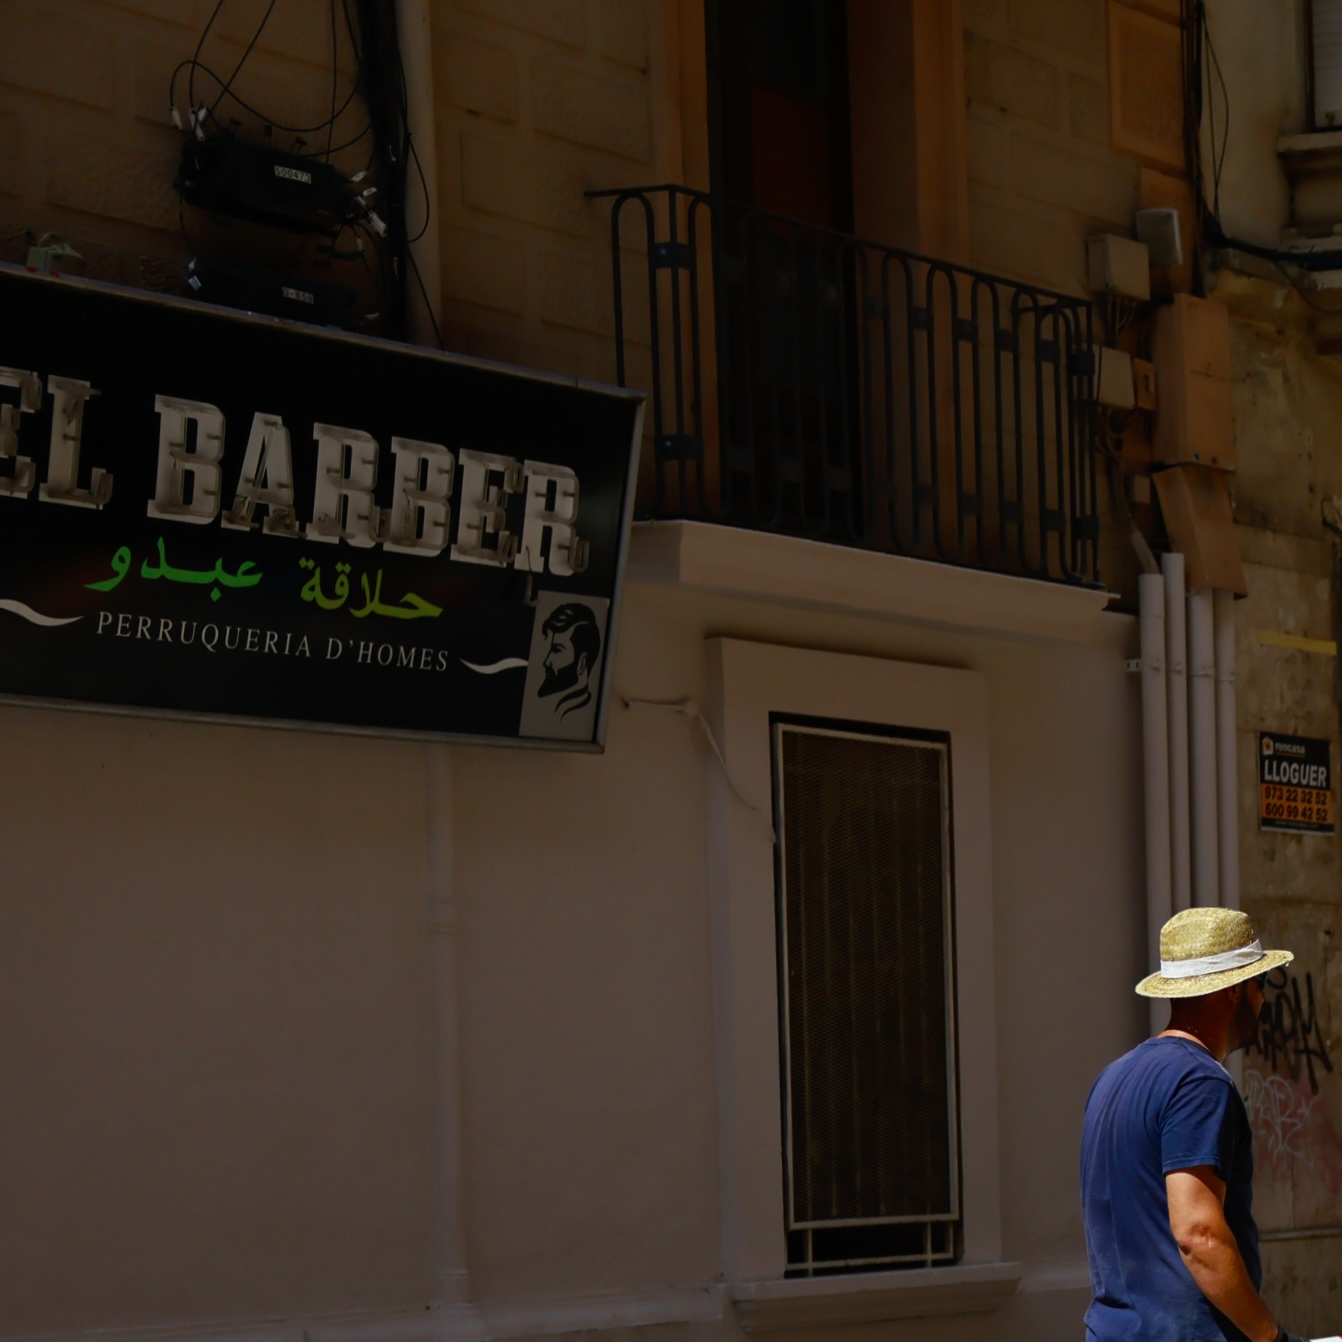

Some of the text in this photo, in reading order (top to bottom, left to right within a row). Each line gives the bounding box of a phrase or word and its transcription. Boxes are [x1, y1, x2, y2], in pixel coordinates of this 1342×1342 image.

[147, 394, 590, 577] BARBER
[83, 535, 444, 620] حلاقة عبدو
[95, 610, 449, 672] PERRUQUERIA D'HOMES
[1263, 759, 1328, 788] LLOGUER
[1264, 785, 1328, 806] 973 22 32 52
[1265, 802, 1328, 822] 600 99 42 52
